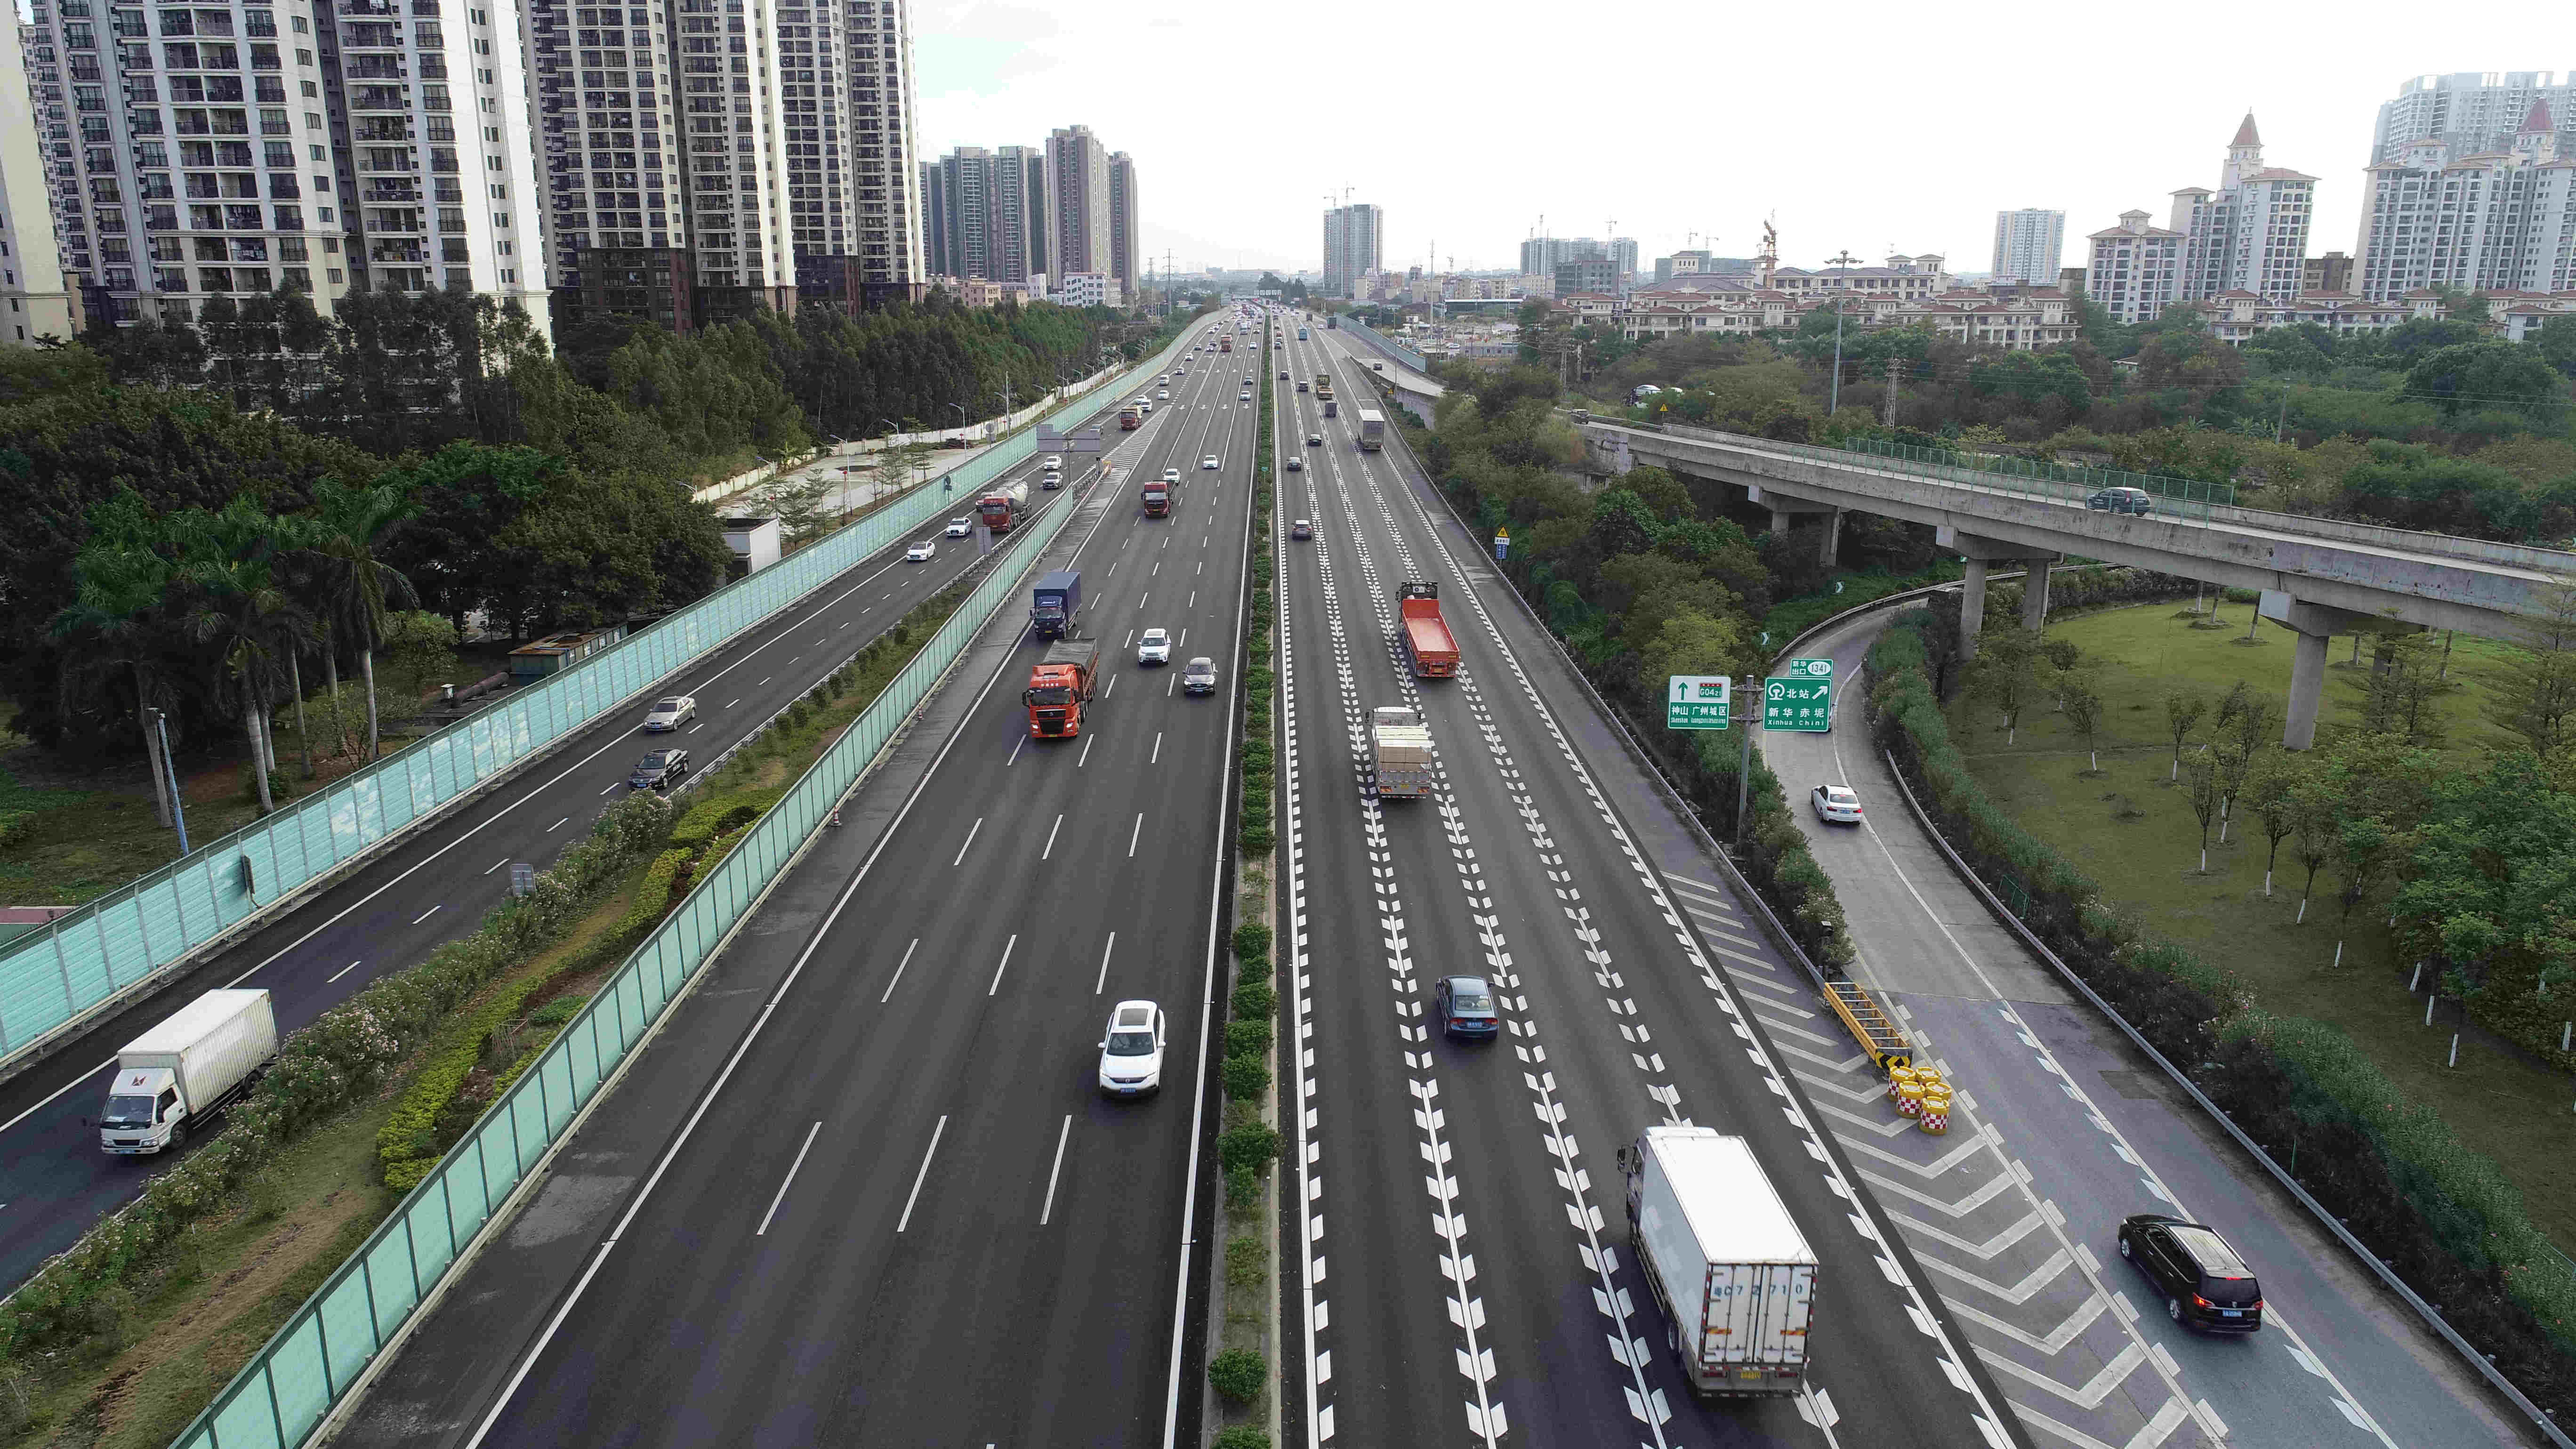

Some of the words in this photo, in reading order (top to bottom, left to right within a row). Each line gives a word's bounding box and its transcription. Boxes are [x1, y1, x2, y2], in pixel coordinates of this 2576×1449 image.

[1700, 688, 1721, 696] G0421
[1787, 689, 1810, 699] 北站
[1671, 706, 1689, 715] 神山
[1692, 706, 1726, 716] 广州城区
[1769, 708, 1793, 717] 新华
[1800, 708, 1824, 717] 赤坭
